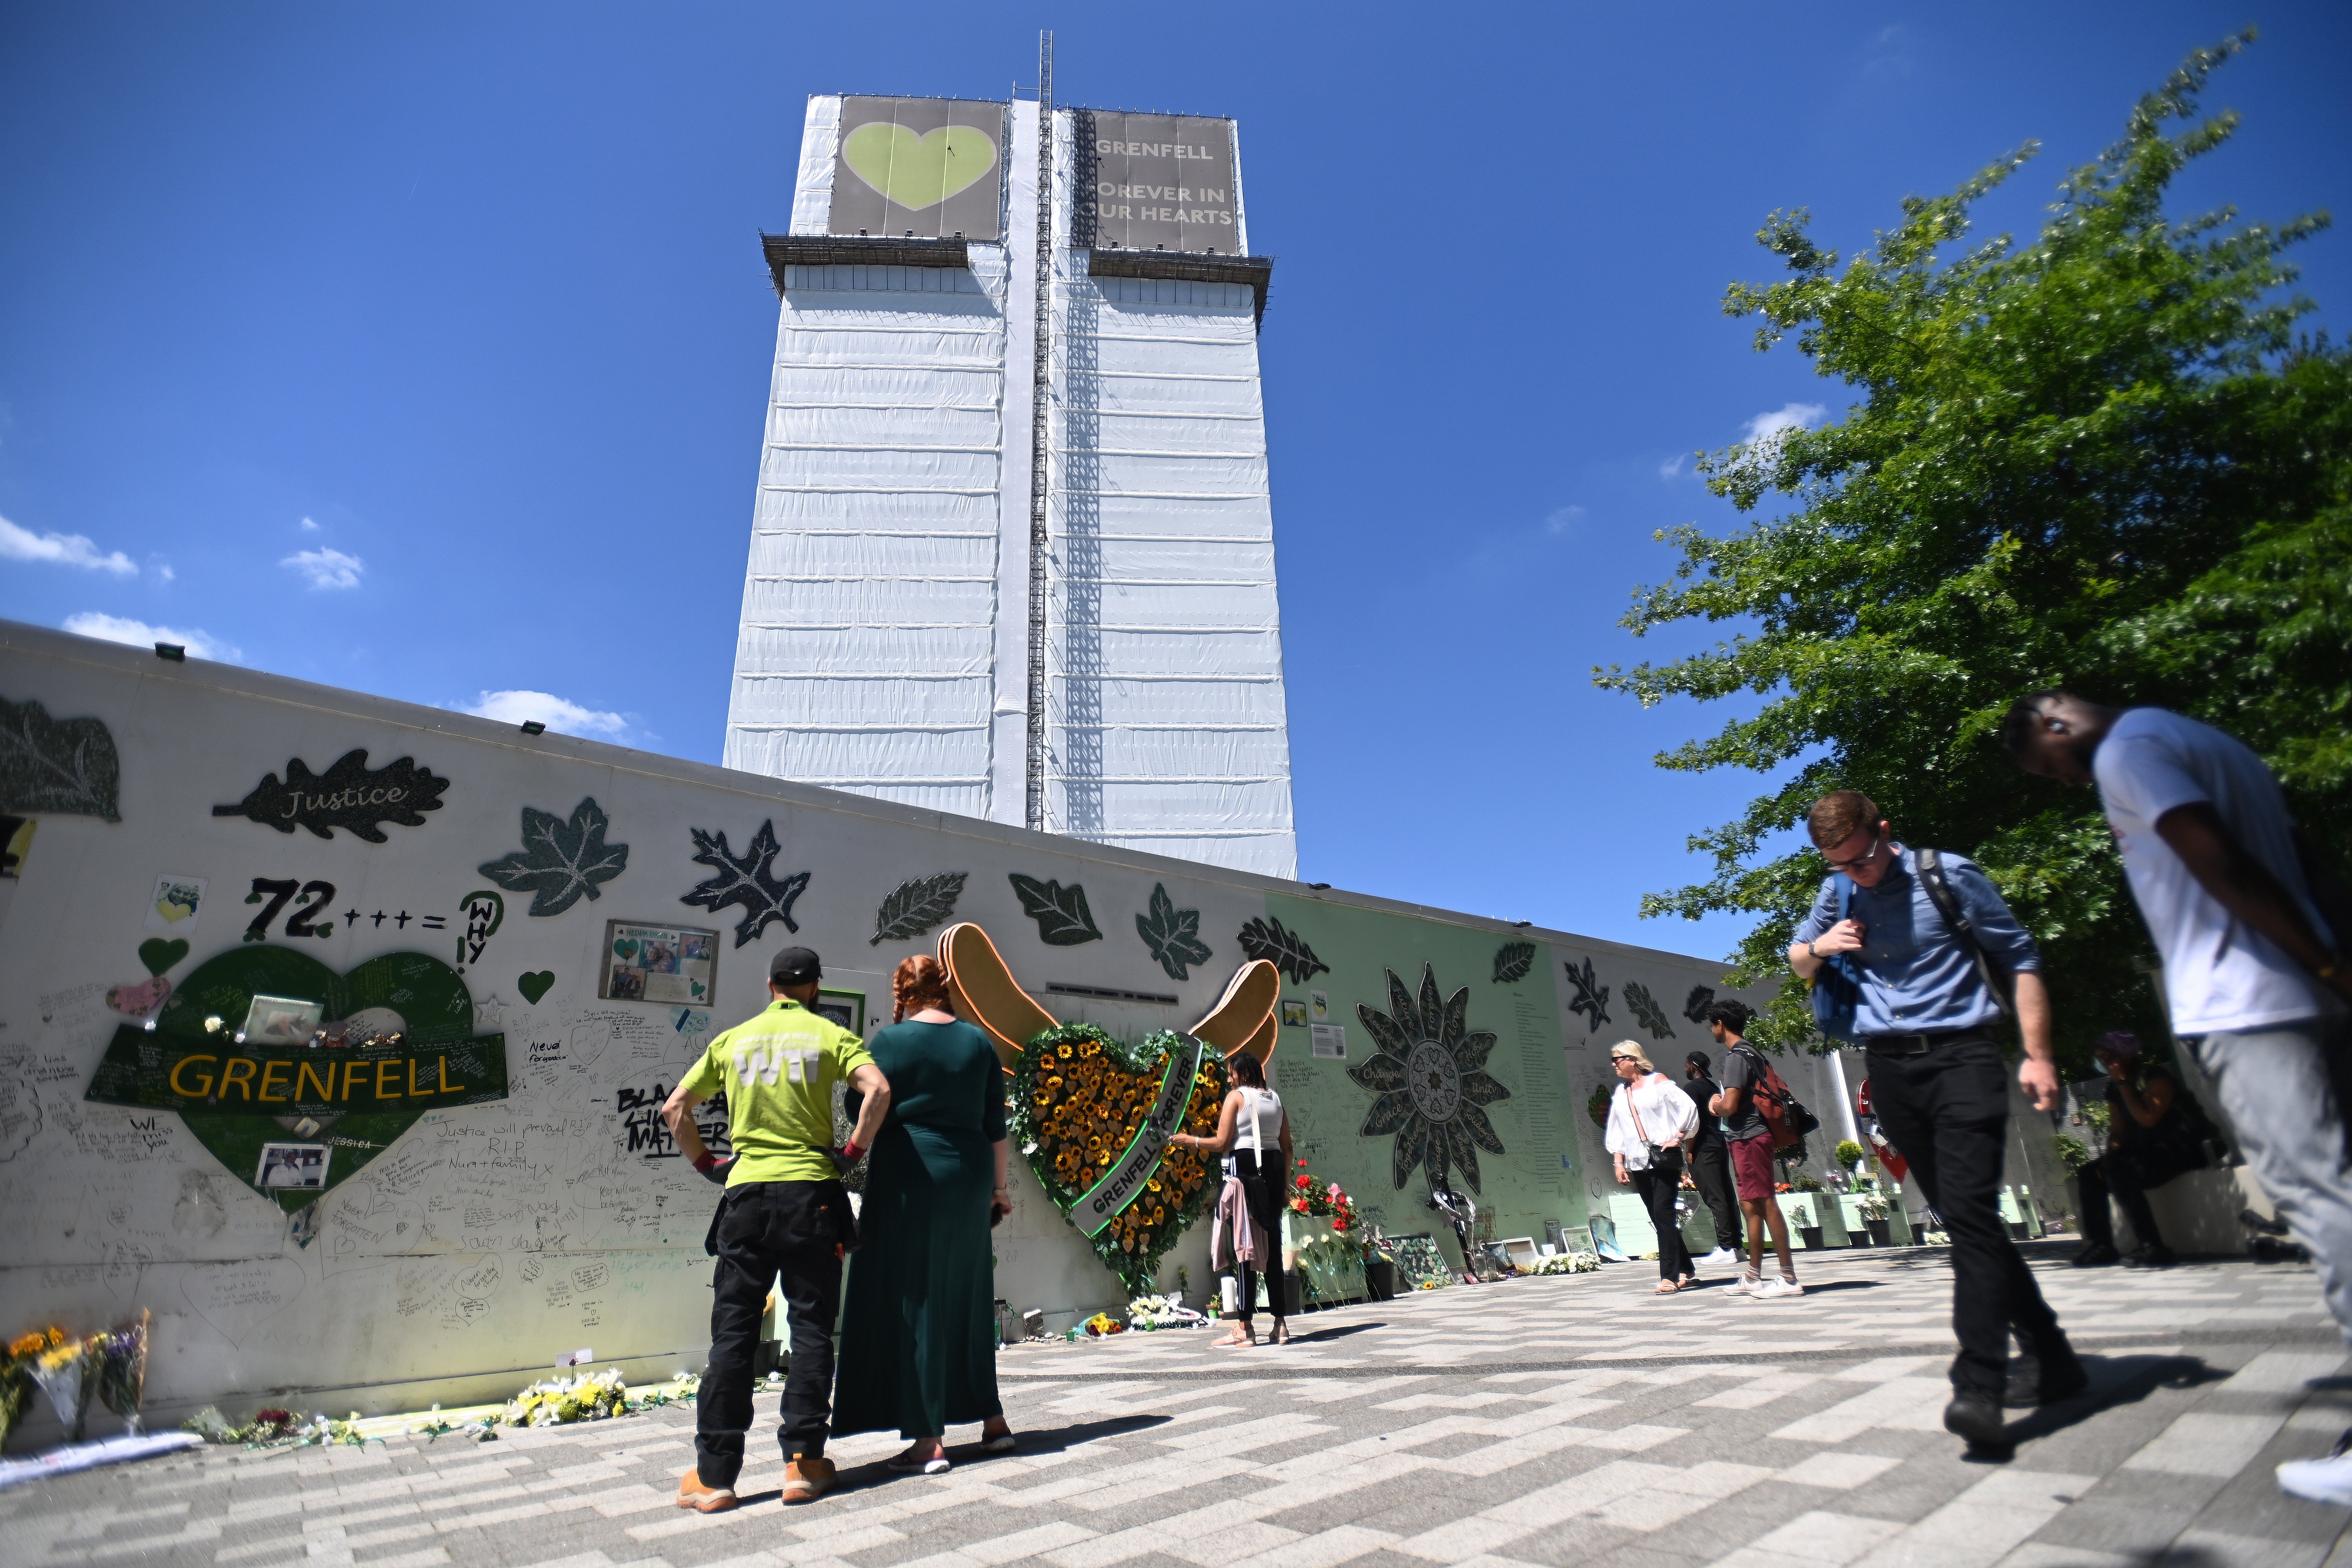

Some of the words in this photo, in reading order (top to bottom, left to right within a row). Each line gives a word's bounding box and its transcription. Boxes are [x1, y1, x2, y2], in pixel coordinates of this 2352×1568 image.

[1096, 139, 1213, 160] GRENFELL
[1200, 188, 1225, 203] IN
[1141, 206, 1232, 225] HEARTS
[280, 786, 409, 819] Justice
[247, 877, 337, 936] 72
[1445, 1004, 1462, 1042] Love
[529, 1040, 561, 1053] Never
[1465, 1041, 1487, 1059] Hope
[170, 1054, 465, 1102] GRENFELL
[1363, 1068, 1400, 1083] Change
[1161, 1057, 1194, 1132] FOREVER
[1472, 1083, 1498, 1096] Unity
[130, 1115, 165, 1131] WE
[1375, 1101, 1403, 1128] Grace
[142, 1127, 173, 1142] miss
[430, 1119, 486, 1138] Justice
[493, 1123, 516, 1135] will
[628, 1122, 731, 1153] MATER
[147, 1140, 169, 1154] you
[488, 1137, 525, 1157] RIP
[449, 1152, 476, 1170] Nura
[491, 1156, 538, 1181] family
[615, 1184, 628, 1195] will
[1092, 1146, 1157, 1214] GRENFELL
[341, 1197, 363, 1220] NEVER
[330, 1209, 382, 1244] FORGOTTEN
